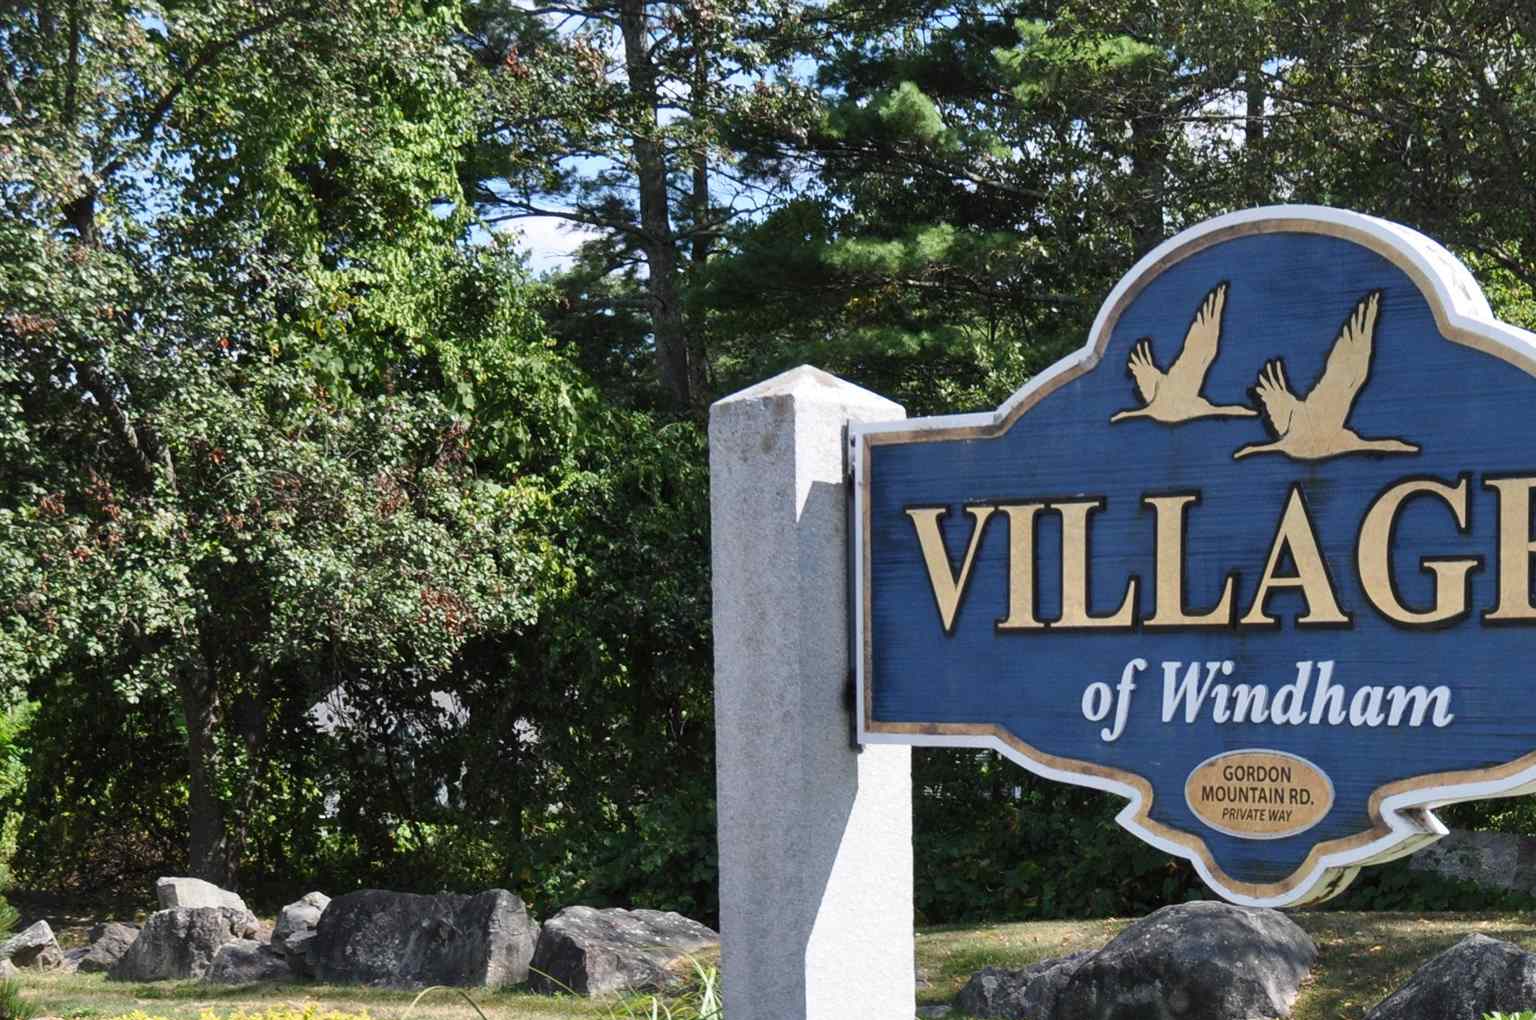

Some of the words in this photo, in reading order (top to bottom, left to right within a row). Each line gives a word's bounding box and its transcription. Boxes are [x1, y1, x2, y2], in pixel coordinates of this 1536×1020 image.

[1081, 658, 1147, 741] of
[1160, 660, 1454, 727] Windham
[1223, 765, 1291, 783] GORDON
[1201, 785, 1285, 804] MOUNTAIN
[1289, 789, 1314, 806] RD.
[1222, 808, 1266, 821] PRIVATE
[1268, 810, 1293, 822] WAY
